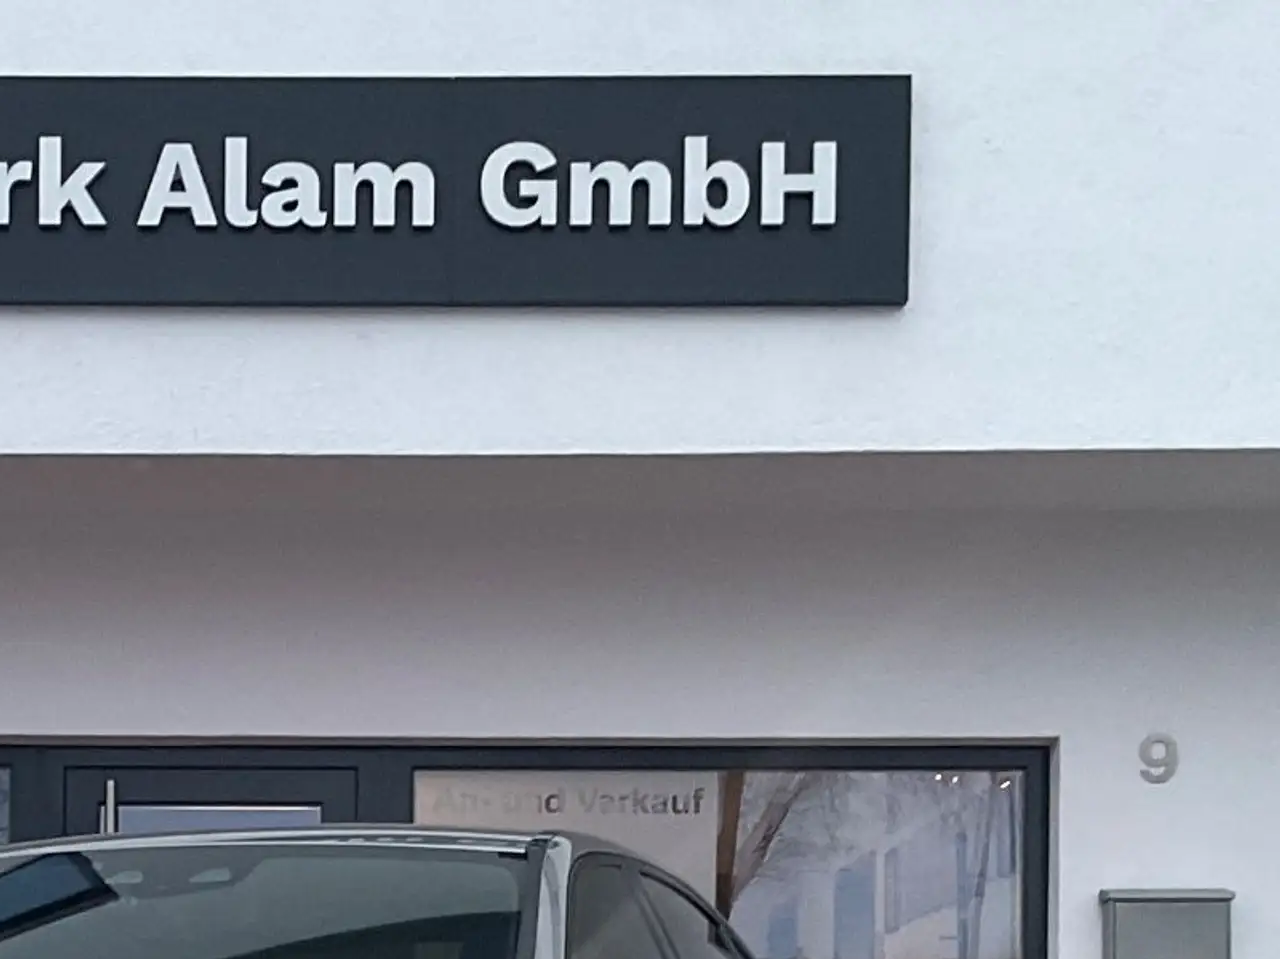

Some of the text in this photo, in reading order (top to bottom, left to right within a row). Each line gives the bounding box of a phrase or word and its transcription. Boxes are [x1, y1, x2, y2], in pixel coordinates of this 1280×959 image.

[135, 136, 435, 227] Alam
[480, 135, 838, 227] GmbH
[1138, 732, 1179, 785] 9
[578, 786, 706, 815] Verkauf
